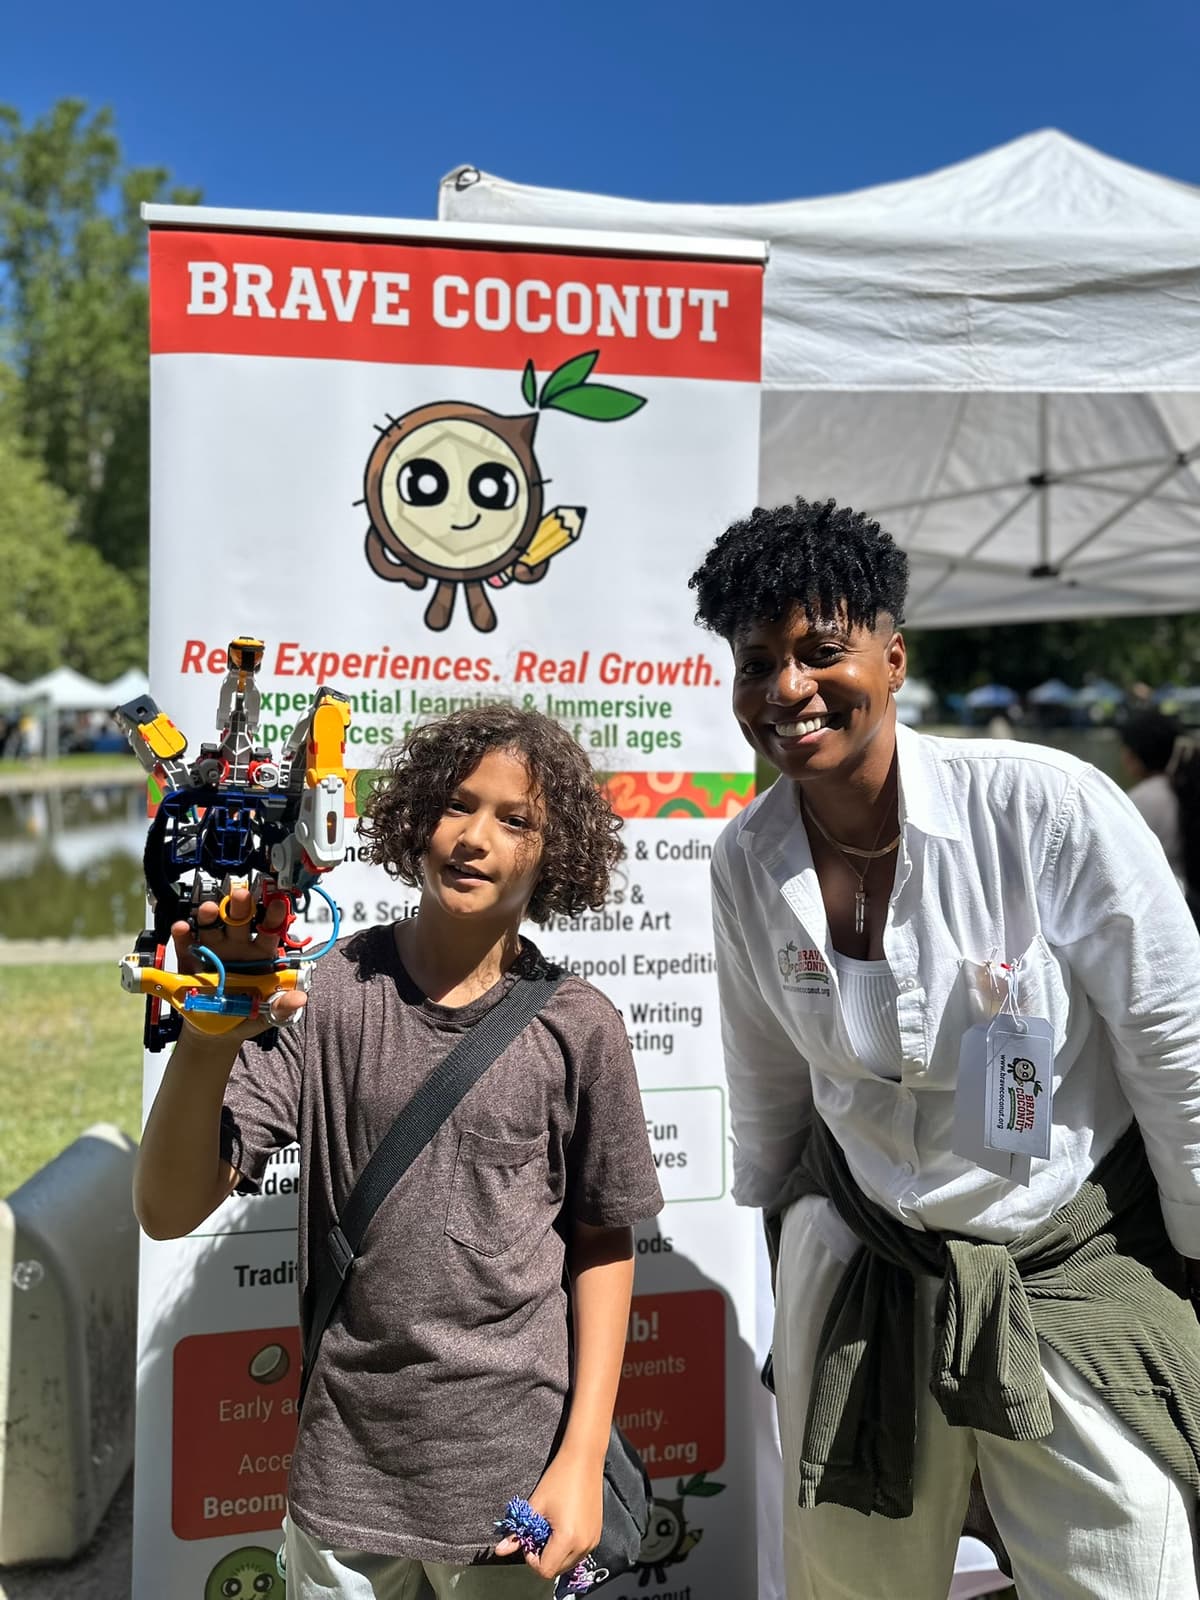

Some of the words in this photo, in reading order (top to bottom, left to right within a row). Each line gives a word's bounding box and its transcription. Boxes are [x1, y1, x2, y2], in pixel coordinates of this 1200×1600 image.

[187, 261, 410, 327] BRAVE
[433, 274, 729, 342] COCONUT
[274, 642, 500, 686] Experiences.
[514, 651, 589, 684] Real
[599, 652, 721, 687] Growth.
[521, 693, 537, 713] &
[546, 694, 673, 719] Immersive
[589, 724, 618, 748] all
[627, 729, 682, 753] ages
[635, 840, 648, 860] &
[656, 840, 712, 860] Codin
[631, 884, 644, 905] &
[353, 901, 367, 921] &
[640, 911, 671, 931] Art
[634, 953, 717, 979] Expediti
[630, 1002, 702, 1027] Writing
[997, 1054, 1007, 1130] www.bravecoconut.org
[1014, 1087, 1026, 1133] COCONUT
[1024, 1094, 1035, 1130] BRAVE
[220, 1396, 273, 1423] Early
[622, 1355, 686, 1379] events
[239, 1454, 292, 1476] Acce
[204, 1493, 287, 1519] Becom
